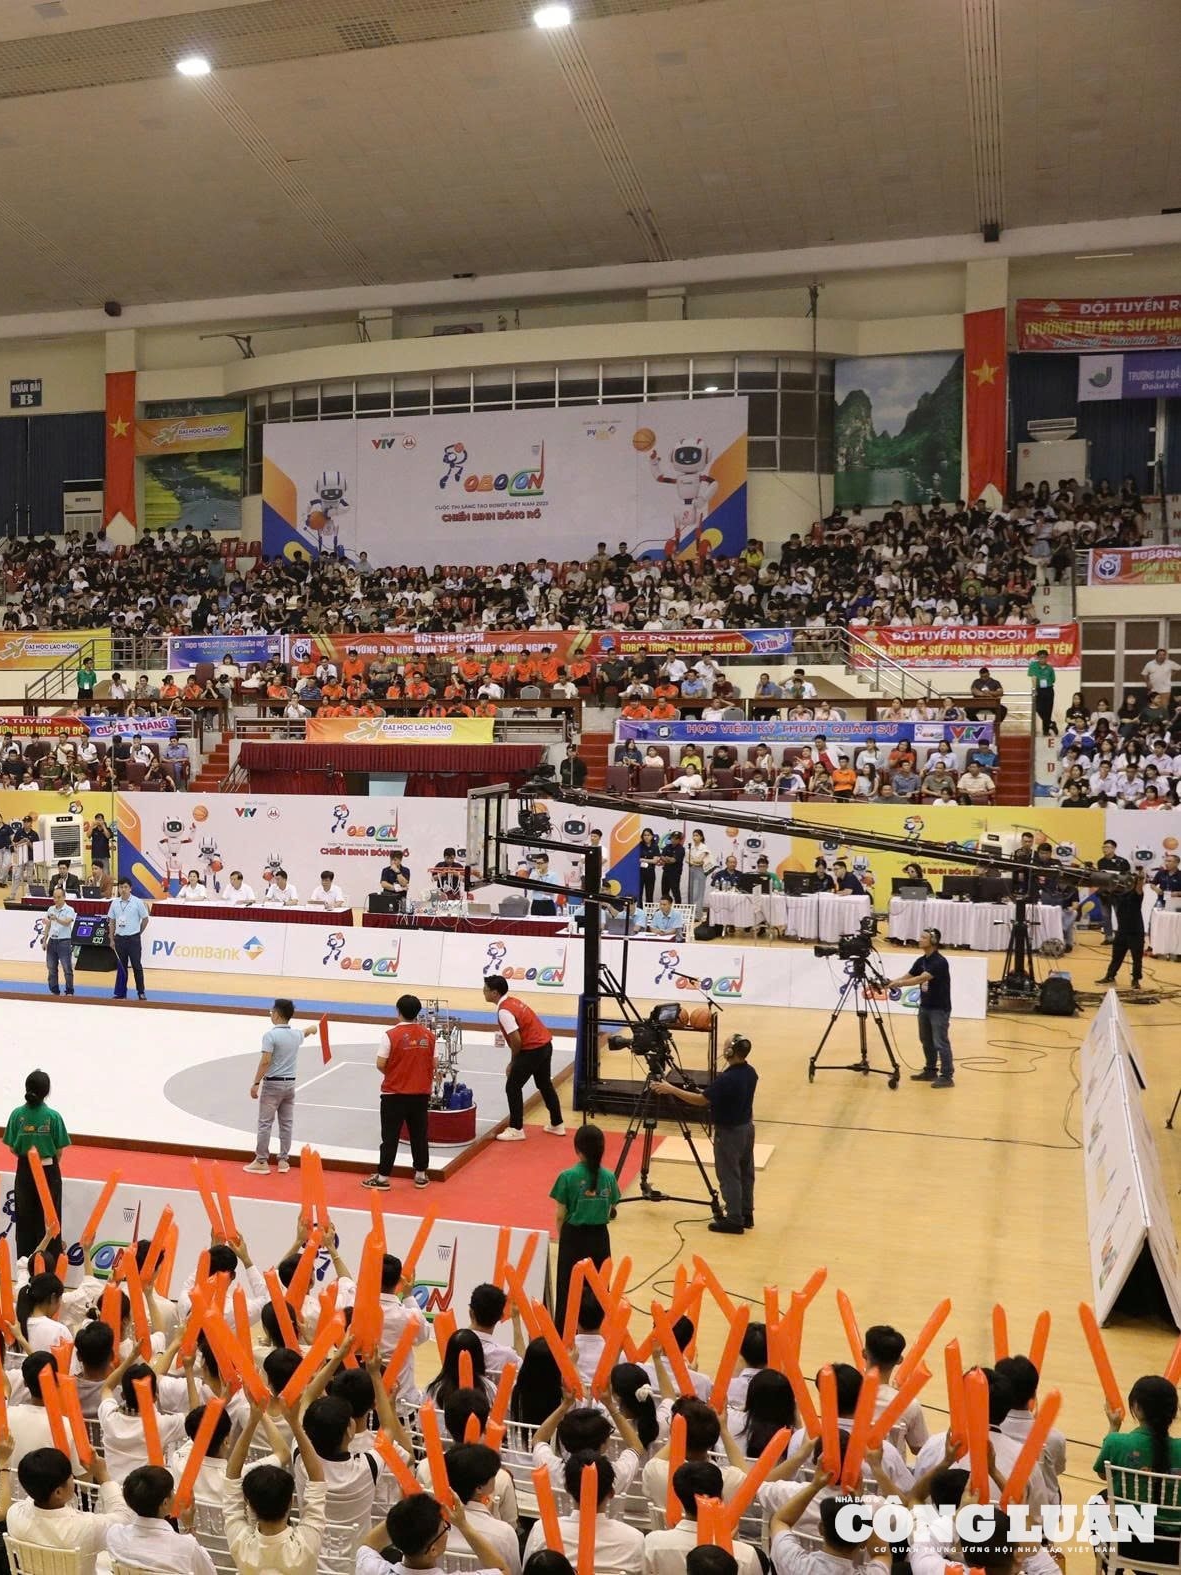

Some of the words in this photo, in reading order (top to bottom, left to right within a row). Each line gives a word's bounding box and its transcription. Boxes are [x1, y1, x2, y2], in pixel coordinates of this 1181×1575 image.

[1080, 300, 1110, 317] ĐỘI
[1114, 298, 1164, 313] TUYỂN
[1099, 320, 1124, 333] HỌC
[371, 439, 395, 450] VTV
[621, 633, 647, 641] CÁC
[892, 631, 916, 642] ĐỘI
[918, 627, 956, 641] TUYỂN
[958, 629, 1027, 641] ROBOCON
[716, 642, 733, 652] SAO
[909, 644, 926, 657] HỌC
[942, 643, 972, 657] PHẠM
[989, 641, 1020, 656] THUẬT
[1052, 641, 1073, 655] YÊN
[9, 716, 52, 724] TUYỂN
[383, 724, 395, 732] ĐẠI
[396, 724, 413, 732] HỌC
[414, 724, 429, 732] LẠC
[430, 722, 452, 731] HỒNG
[686, 723, 717, 736] HỌC
[721, 723, 755, 734] VIỆN
[781, 722, 827, 735] THUẬT
[831, 722, 874, 735] QUÂN
[949, 726, 986, 740] VTV
[235, 807, 257, 818] VTV
[320, 846, 346, 856] CHIẾN
[348, 848, 369, 857] BINH
[152, 940, 240, 961] PVcomBank
